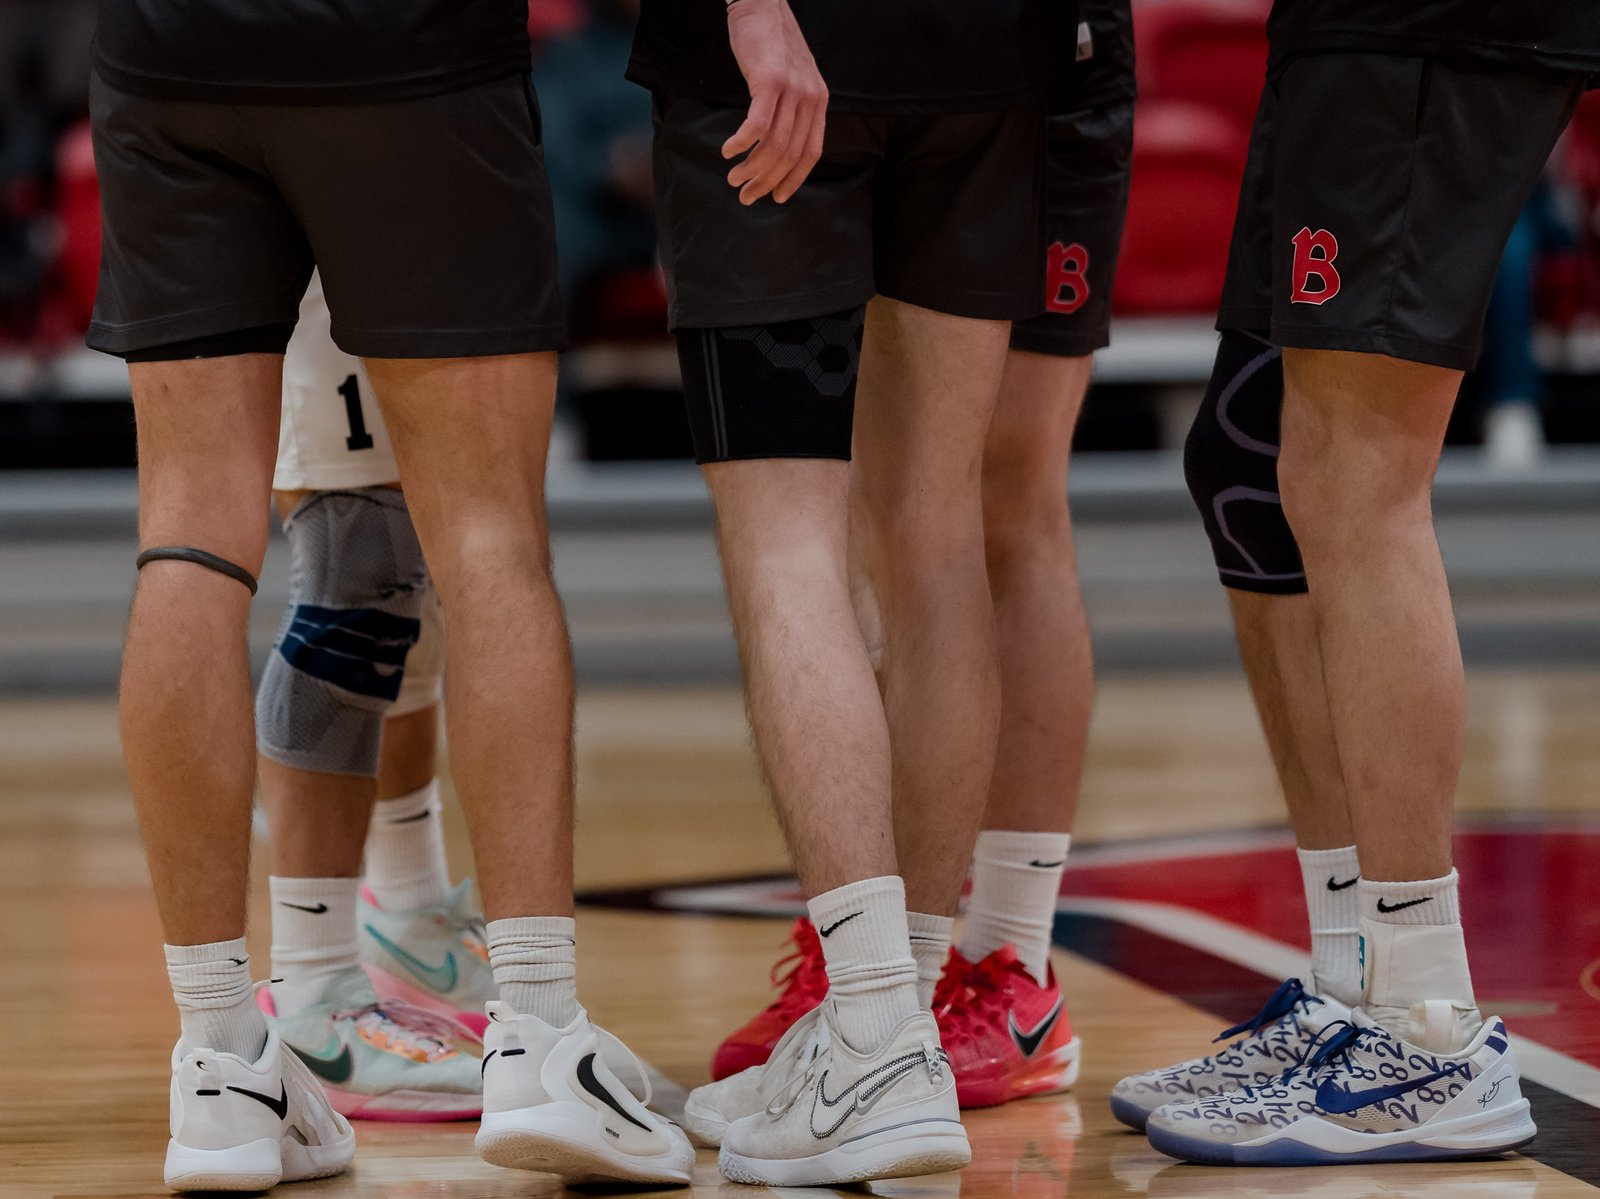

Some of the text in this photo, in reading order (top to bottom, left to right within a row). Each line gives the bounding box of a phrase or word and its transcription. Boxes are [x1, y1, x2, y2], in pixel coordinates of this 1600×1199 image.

[1046, 240, 1089, 314] B
[1291, 226, 1341, 305] B
[337, 373, 374, 452] 1
